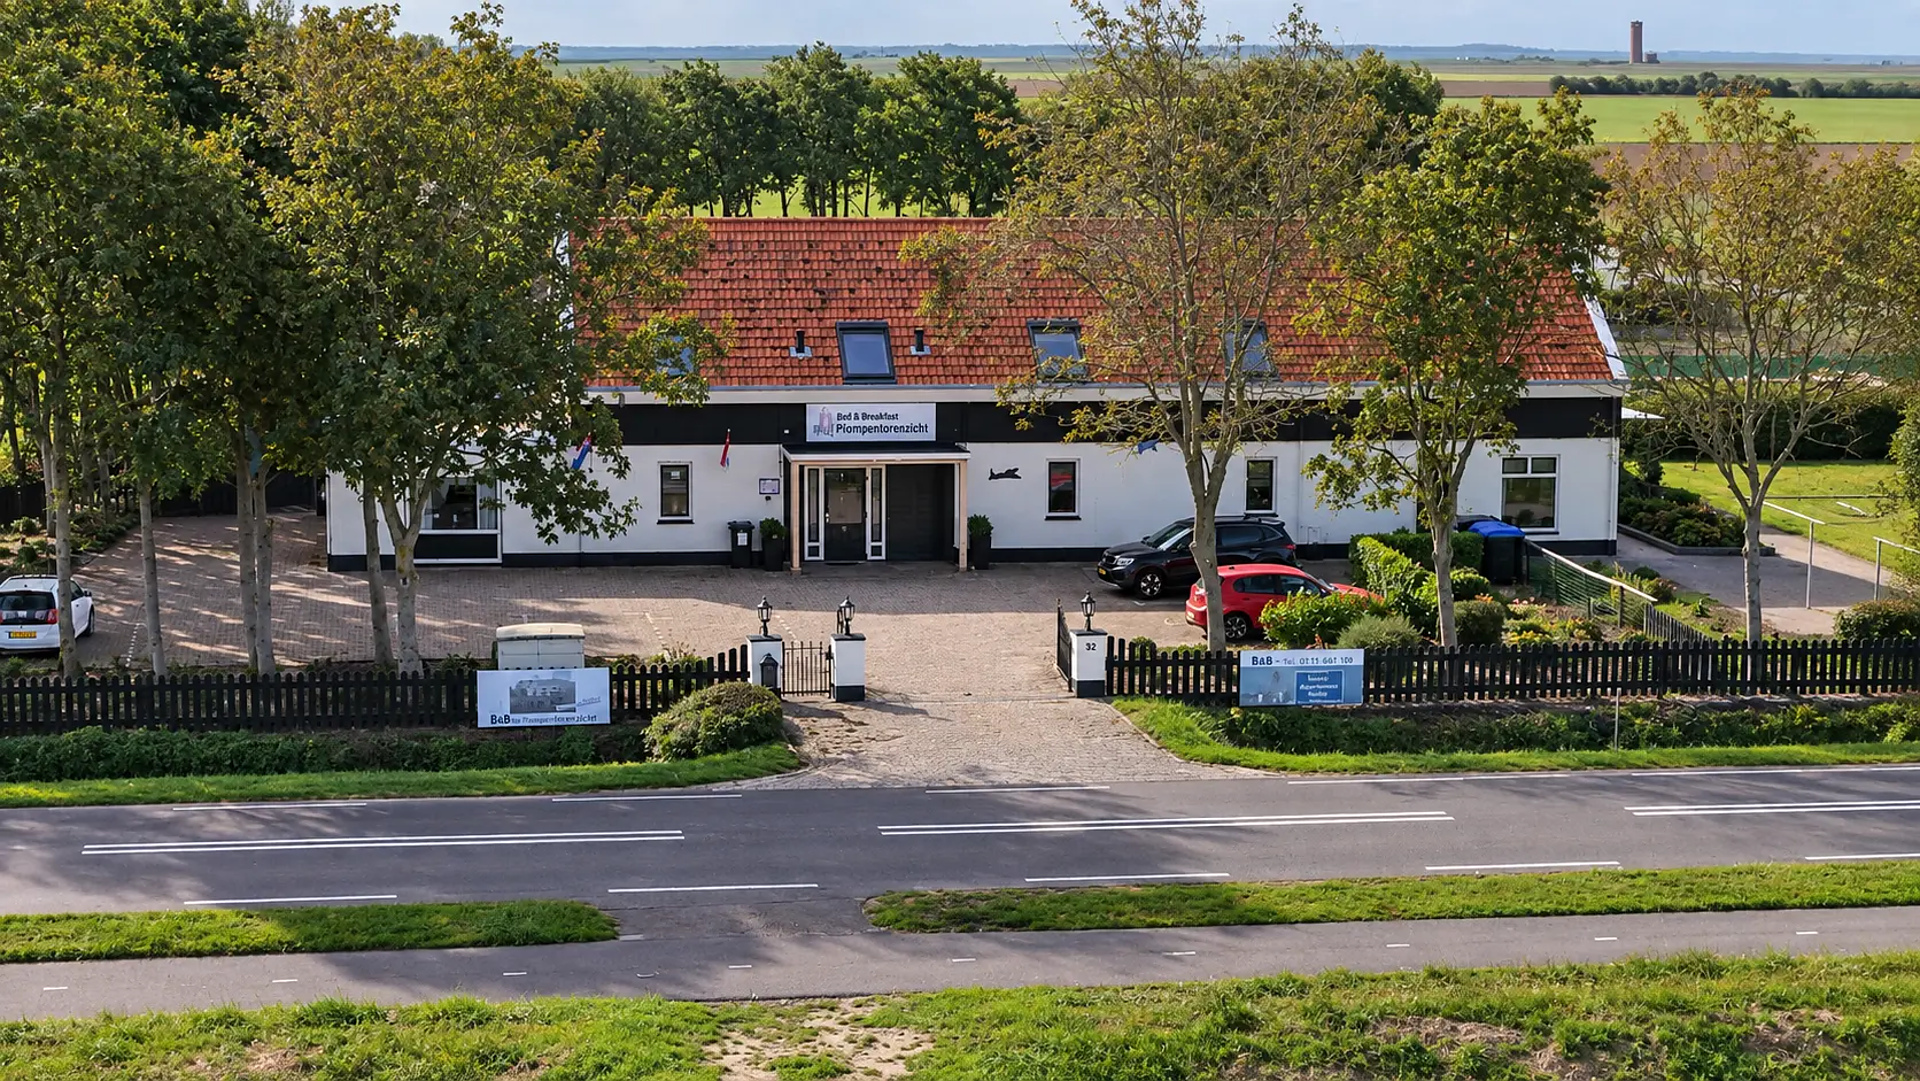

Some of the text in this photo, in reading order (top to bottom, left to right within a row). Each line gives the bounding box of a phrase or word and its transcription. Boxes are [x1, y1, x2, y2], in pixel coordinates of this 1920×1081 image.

[836, 412, 852, 421] Bed
[861, 412, 899, 421] Breakfast
[1085, 642, 1097, 651] 32
